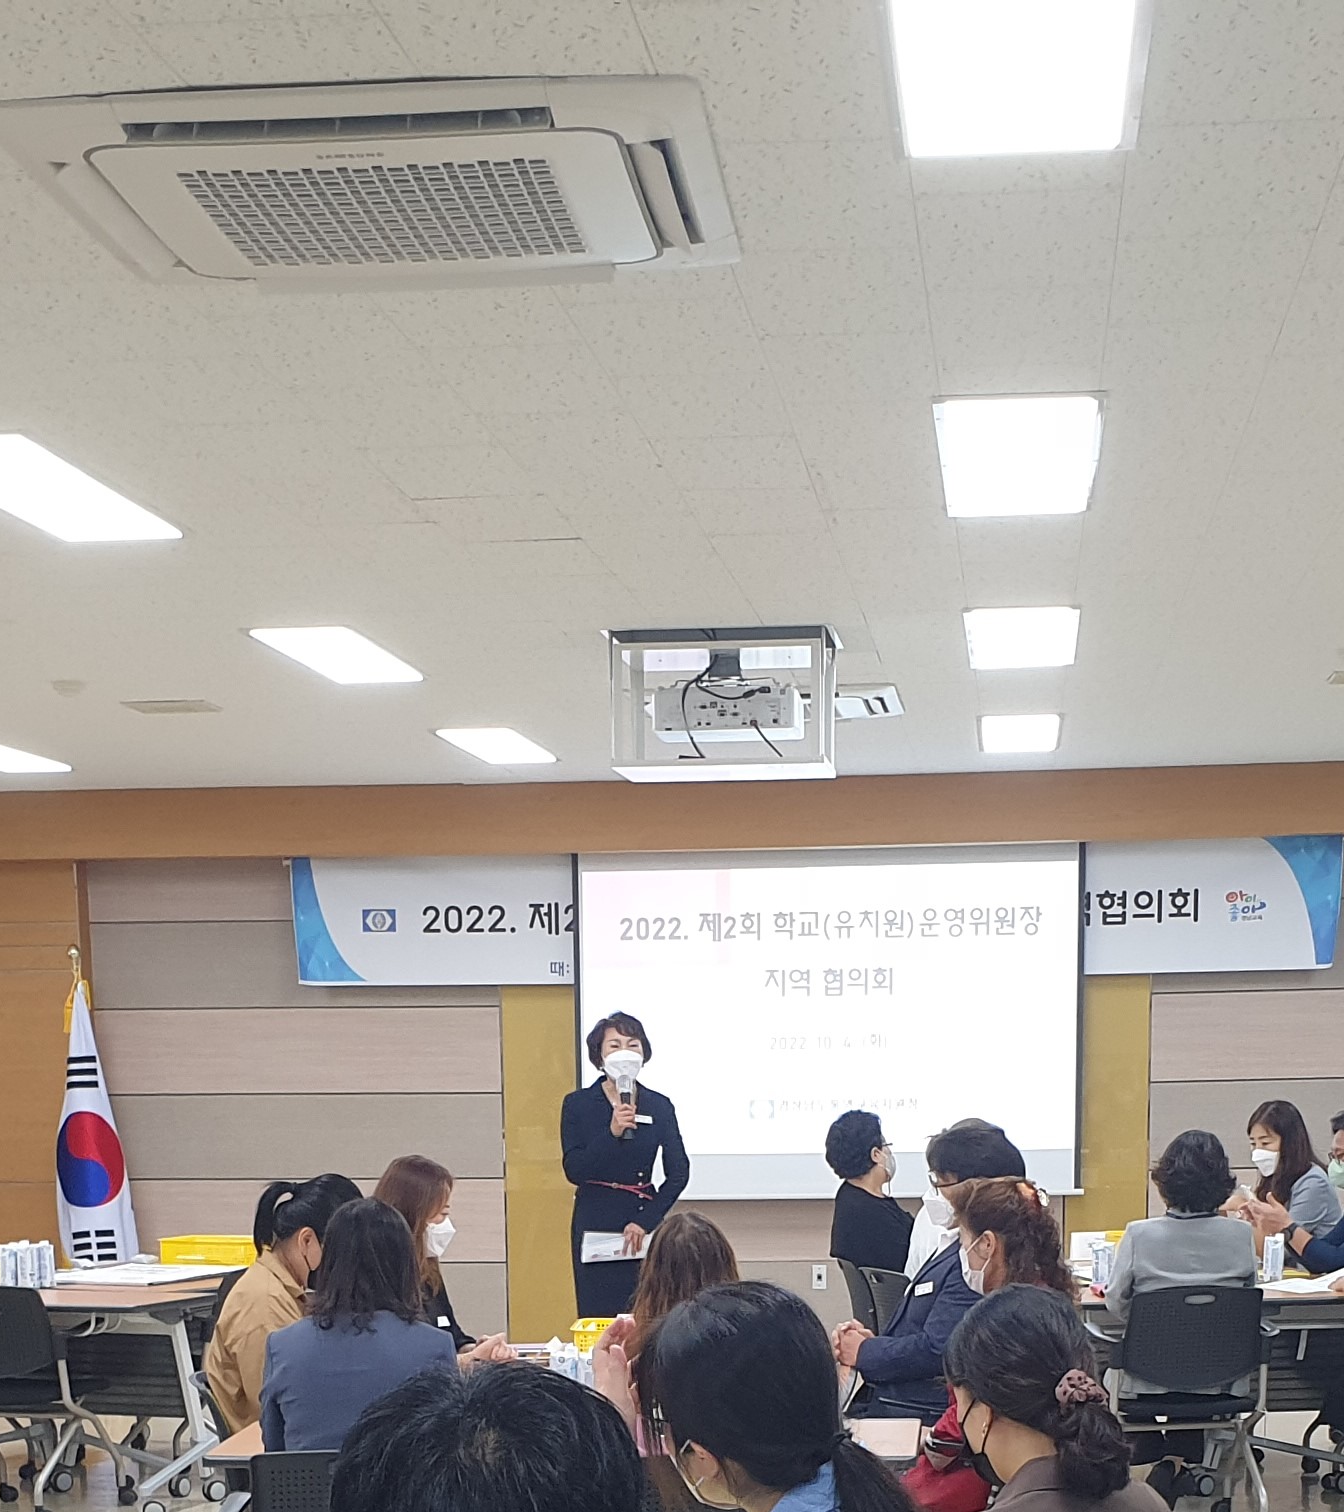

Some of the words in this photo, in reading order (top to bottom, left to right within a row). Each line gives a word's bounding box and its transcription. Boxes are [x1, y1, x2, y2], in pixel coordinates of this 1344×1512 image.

[422, 904, 516, 933] 2022.
[1084, 887, 1199, 926] 협의회
[619, 917, 689, 941] 2022.
[698, 911, 761, 942] 제2회
[773, 906, 1043, 941] 학교(유치원)운영위원장
[764, 969, 811, 997] 지역
[823, 967, 893, 996] 협의회
